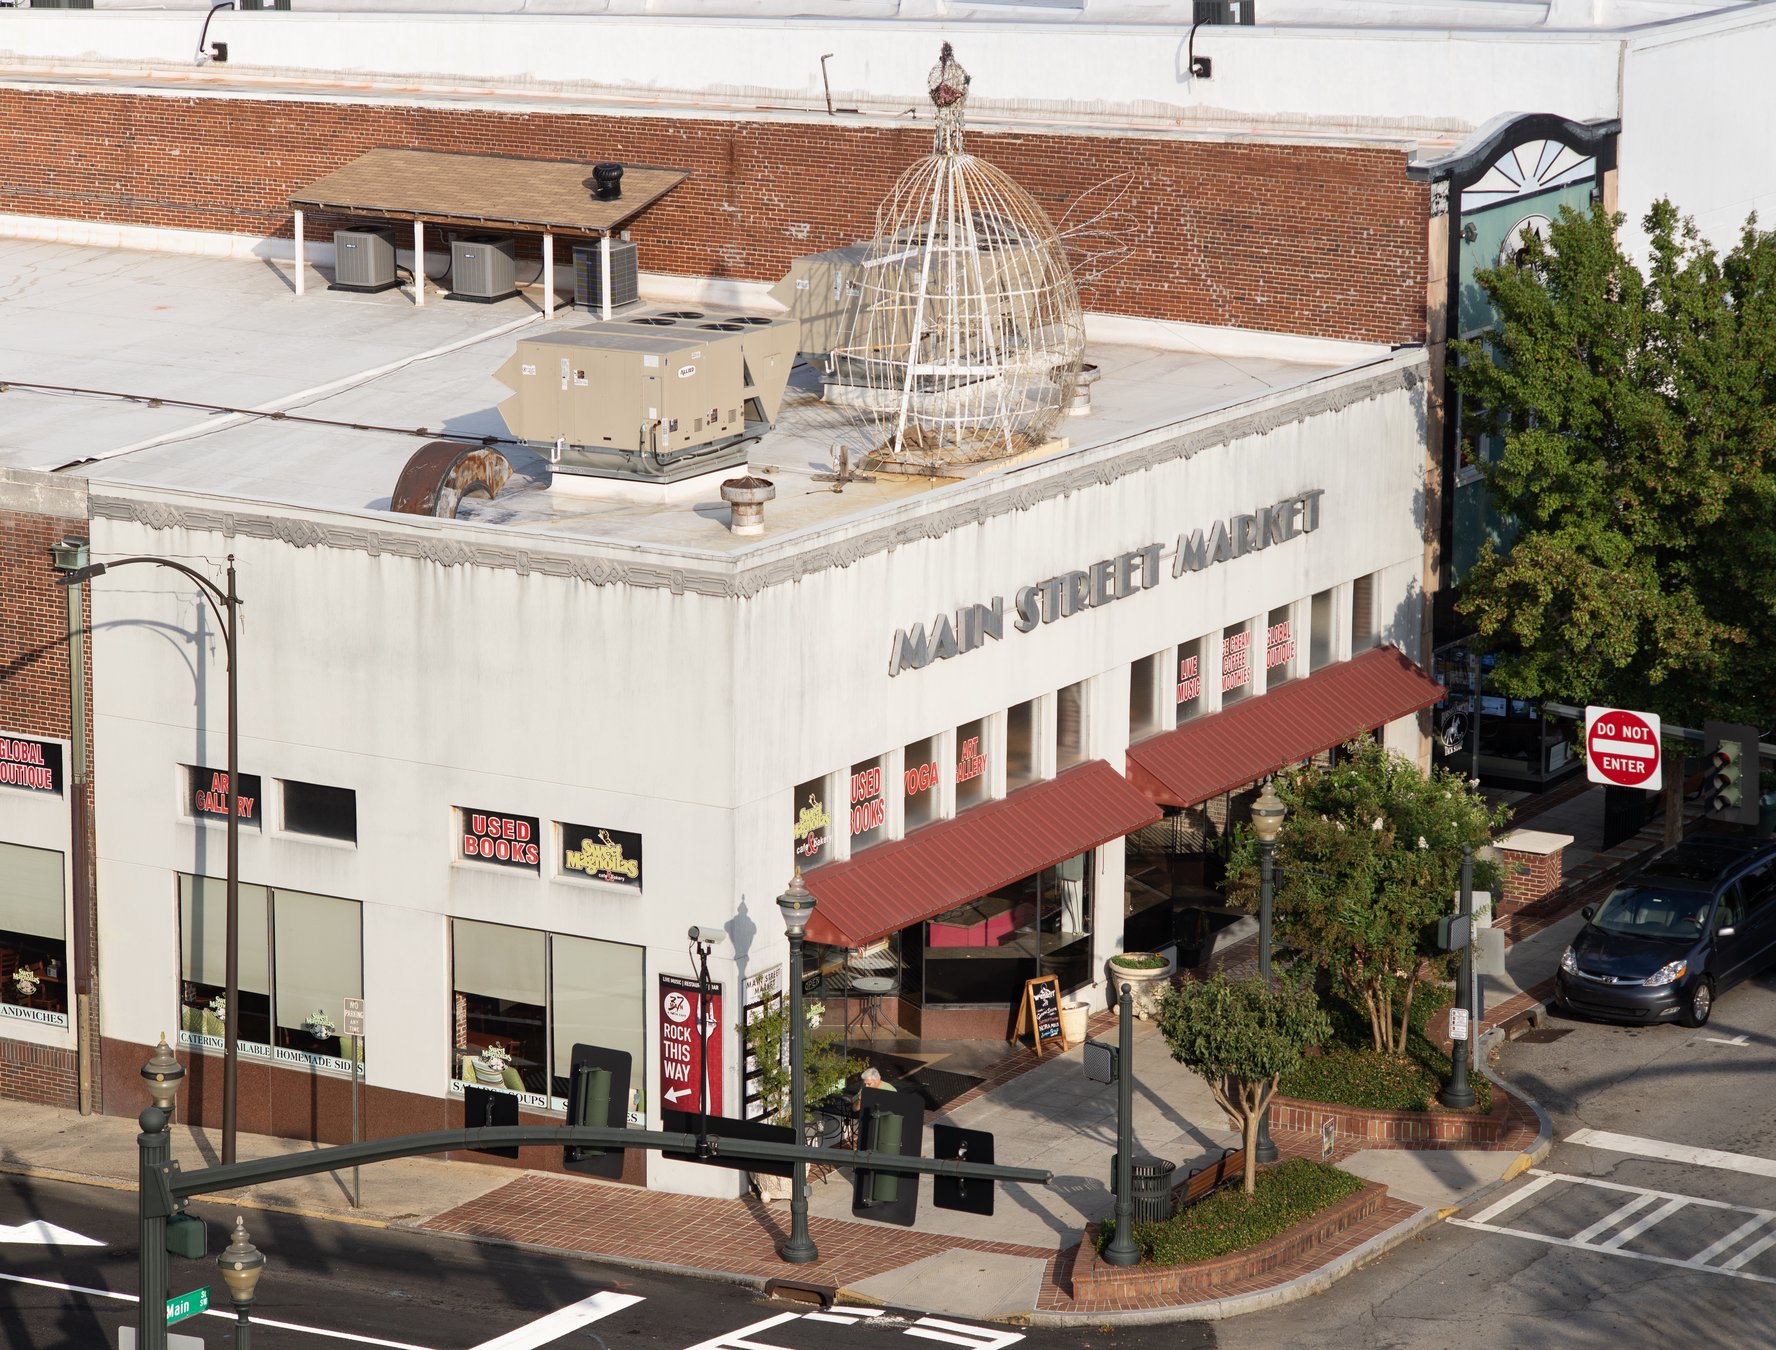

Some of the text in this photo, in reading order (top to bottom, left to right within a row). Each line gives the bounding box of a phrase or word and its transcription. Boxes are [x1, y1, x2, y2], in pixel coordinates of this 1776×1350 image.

[888, 488, 1325, 677] MAIN STREET MARKET
[1230, 630, 1251, 653] CREAM
[1223, 650, 1246, 674] COFFEE
[1266, 640, 1295, 669] OUTIQUE
[1180, 655, 1198, 680] LIVE
[1221, 666, 1251, 692] MOOTHIES
[1177, 676, 1201, 704] MUSIC
[1597, 722, 1649, 740] DO NOT
[0, 738, 45, 765] GLOBAL
[962, 735, 979, 762] ART
[0, 761, 52, 790] OUTIQUE
[956, 753, 988, 783] ALLERY
[1602, 756, 1645, 774] ENTER
[211, 772, 229, 794] AR
[851, 767, 881, 804] USED
[195, 790, 254, 818] GALLRY
[472, 814, 531, 842] USED
[464, 834, 539, 864] BOOKS
[581, 838, 622, 860] Sweet
[566, 849, 639, 878] Magnolias
[0, 1006, 64, 1024] ANDWICHES
[349, 1001, 359, 1009] NO
[668, 996, 684, 1012] 37
[181, 1033, 270, 1056] CATERING AILABLE
[663, 1023, 691, 1043] ROCK
[276, 1049, 363, 1073] HOMEMADE SIDS
[663, 1040, 691, 1062] THIS
[663, 1060, 691, 1082] WAY
[167, 1300, 190, 1319] Main
[199, 1297, 208, 1307] SW
